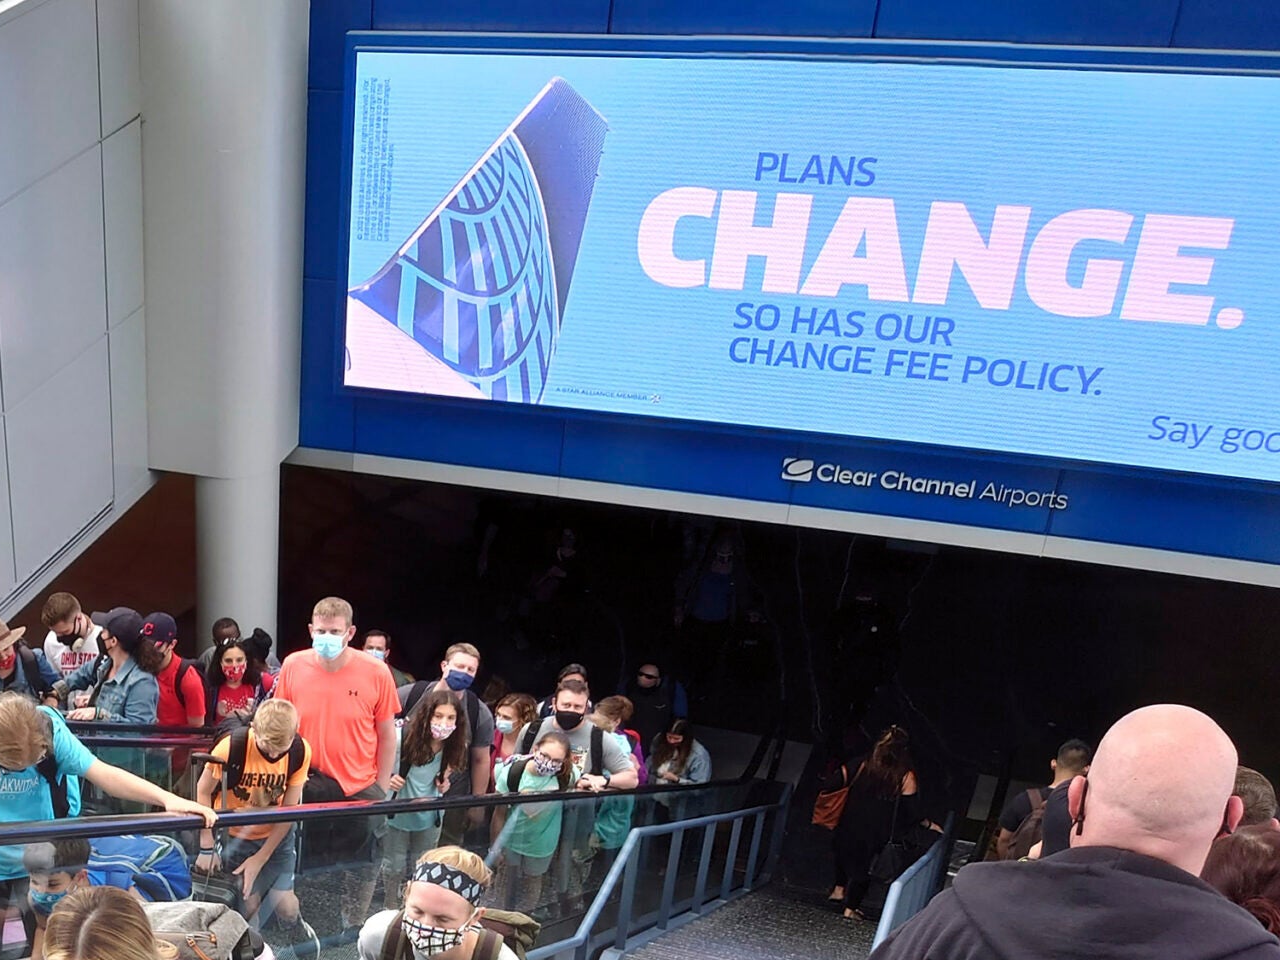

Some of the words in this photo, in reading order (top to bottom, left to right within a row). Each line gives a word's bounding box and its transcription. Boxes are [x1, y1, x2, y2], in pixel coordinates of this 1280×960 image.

[754, 152, 877, 187] PLANS
[637, 186, 1244, 330] CHANGE.
[733, 302, 781, 331] SO
[790, 306, 866, 338] HAS
[874, 312, 956, 347] OUR
[728, 336, 876, 375] CHANGE
[885, 349, 953, 382] FEE
[961, 355, 1105, 396] POLICY.
[1148, 415, 1213, 449] Say
[816, 463, 877, 488] Clear
[880, 470, 977, 499] Channel
[979, 481, 1069, 511] Airports
